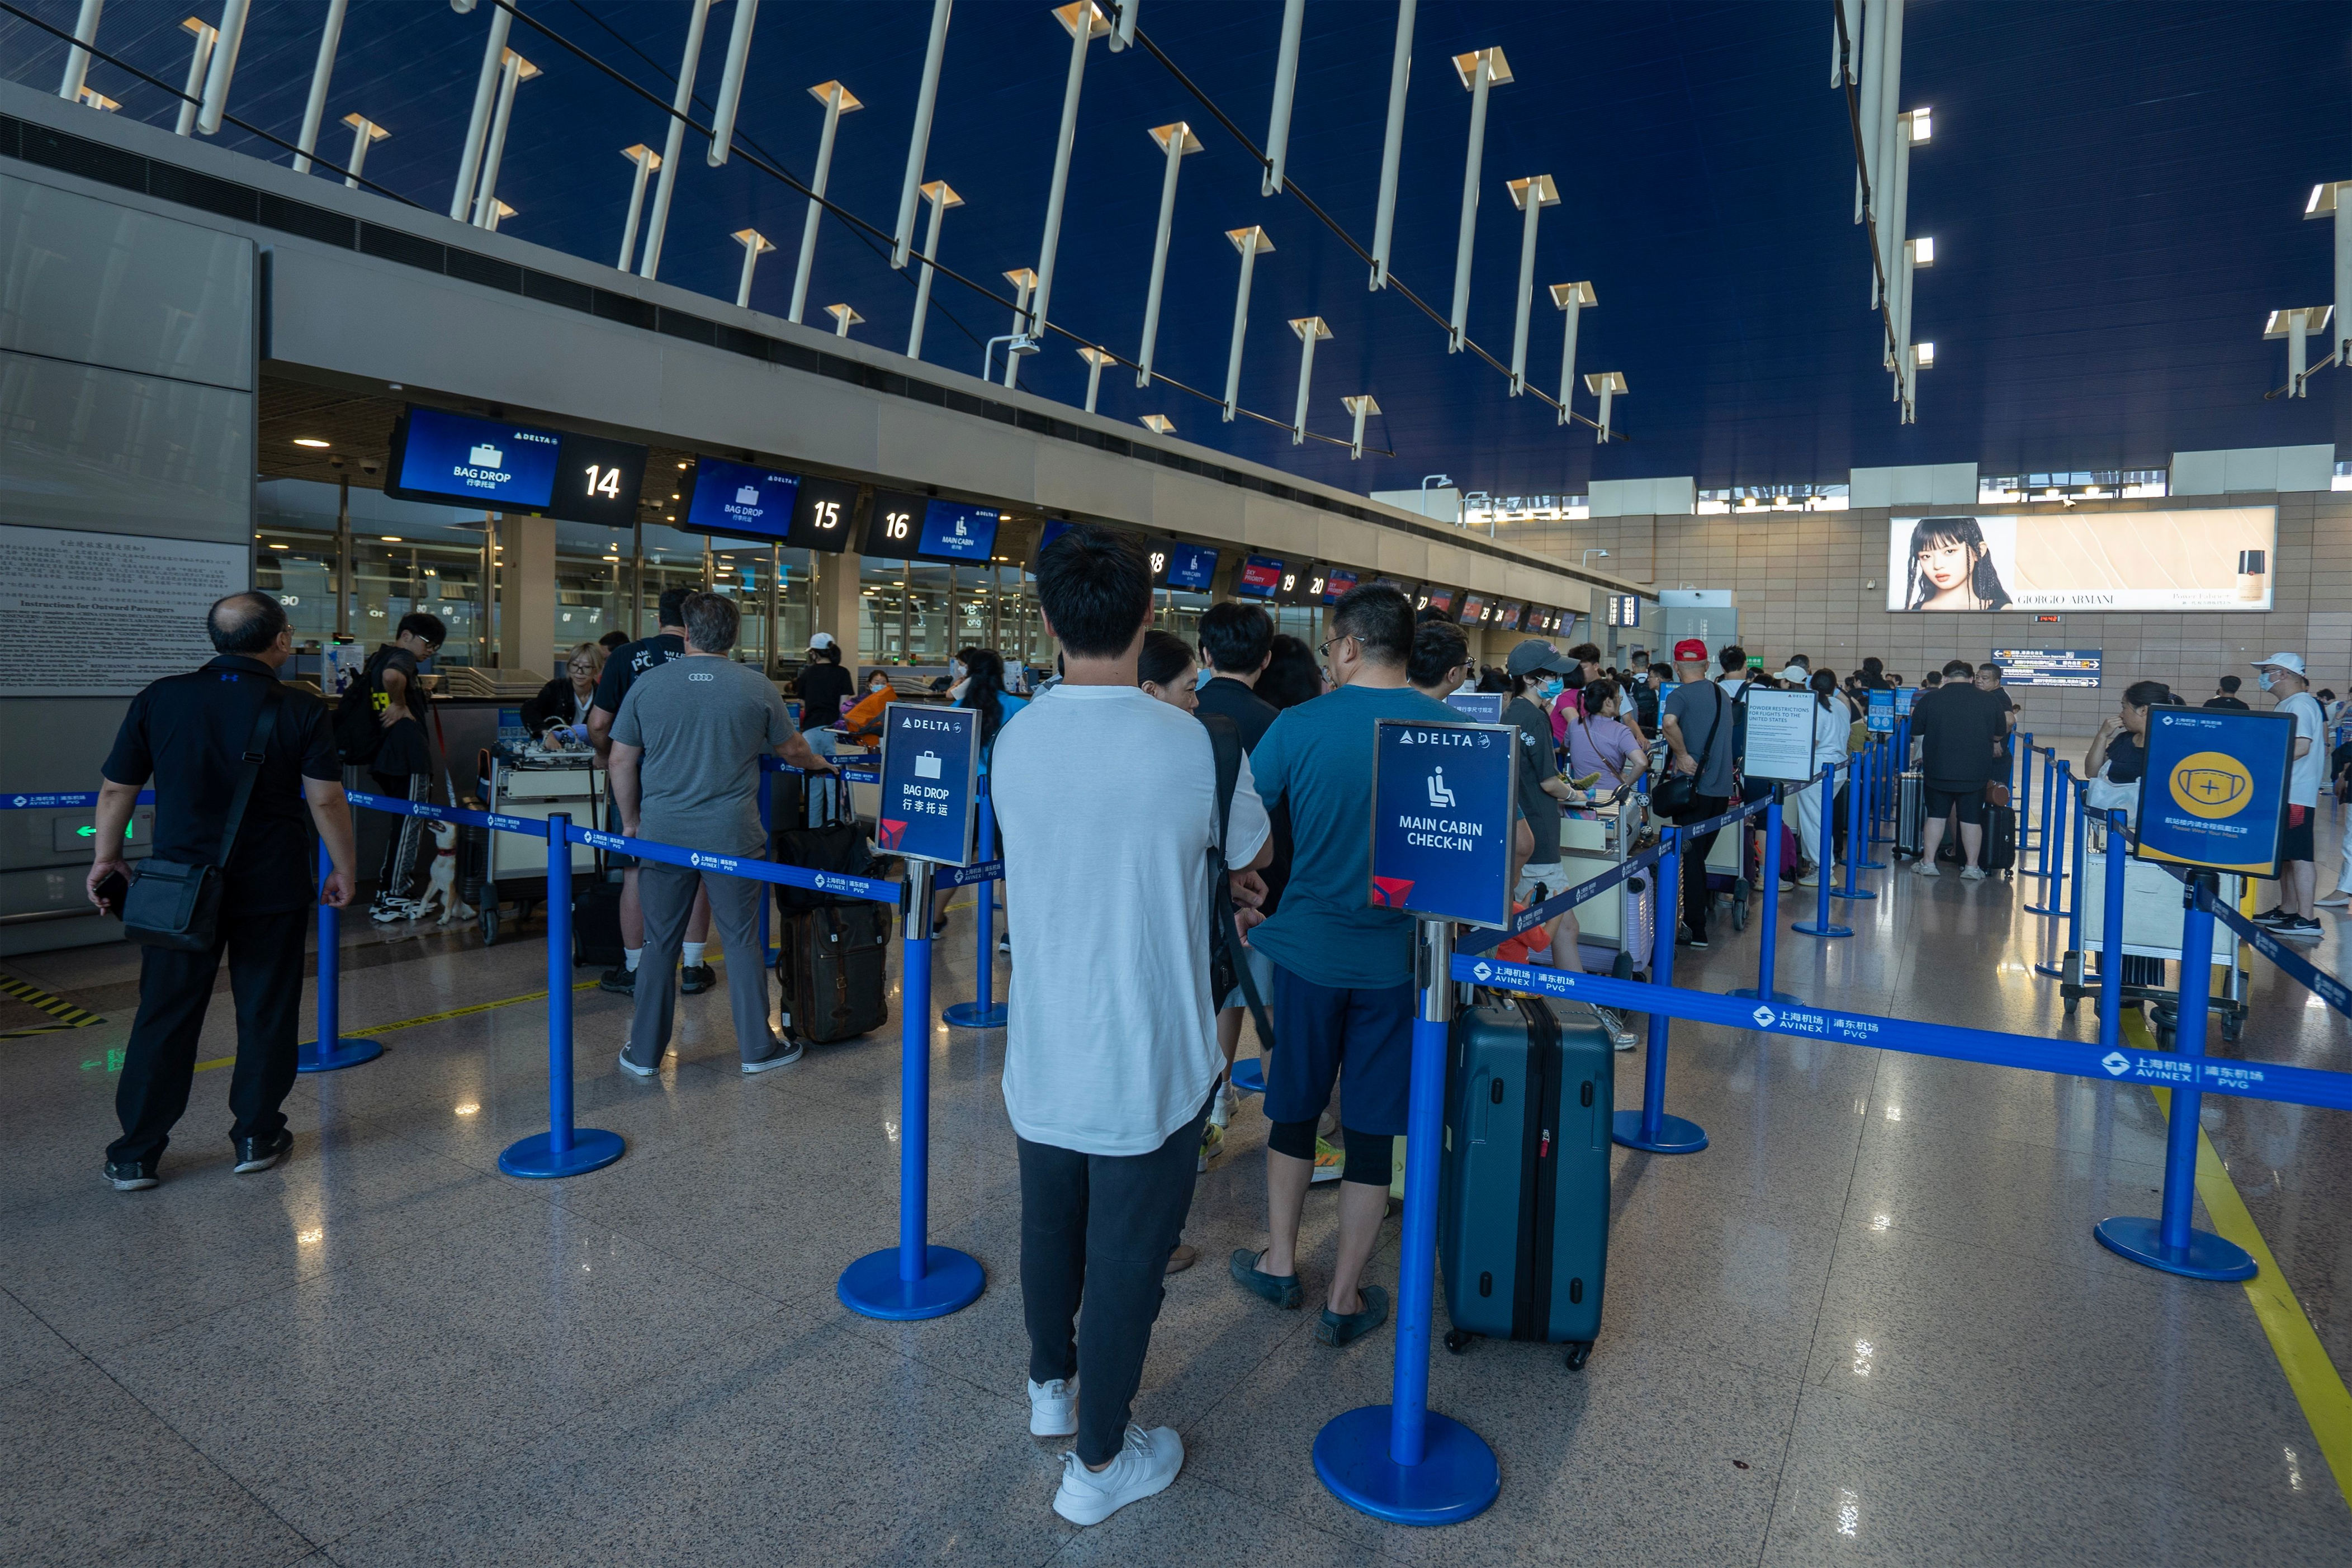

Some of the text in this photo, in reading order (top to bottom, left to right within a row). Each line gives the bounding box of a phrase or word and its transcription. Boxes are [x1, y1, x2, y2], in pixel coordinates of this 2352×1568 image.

[523, 432, 550, 443] DELTA
[454, 466, 512, 483] BAG DROP
[585, 465, 620, 499] 14
[774, 476, 792, 484] DELTA
[466, 479, 495, 489] 行李托运
[725, 504, 764, 518] BAG DROP
[815, 501, 840, 529] 15
[886, 512, 910, 539] 16
[942, 536, 974, 546] MAIN CABIN
[1149, 552, 1165, 572] 18
[1283, 575, 1295, 591] 19
[1309, 577, 1324, 594] 20
[21, 600, 75, 609] Instructions
[131, 605, 174, 613] Passengers
[2018, 595, 2113, 604] GIORGIO ARMANI
[914, 719, 950, 732] DELTA
[1418, 732, 1473, 747] DELTA
[903, 784, 949, 800] BAG DROP
[902, 798, 948, 817] 行李托运
[1399, 815, 1483, 837] MAIN CABIN
[1407, 832, 1473, 852] CHECK-IN
[1494, 975, 1566, 992] AVINEX PVG
[1495, 966, 1575, 986] 上海机场 浦东机场
[1779, 1021, 1867, 1039] AVINEX PVG
[1780, 1011, 1879, 1032] 上海机场 浦东机场
[2136, 1057, 2264, 1082] 上海机场 浦东机场
[2135, 1068, 2250, 1089] AVINEX PVG
